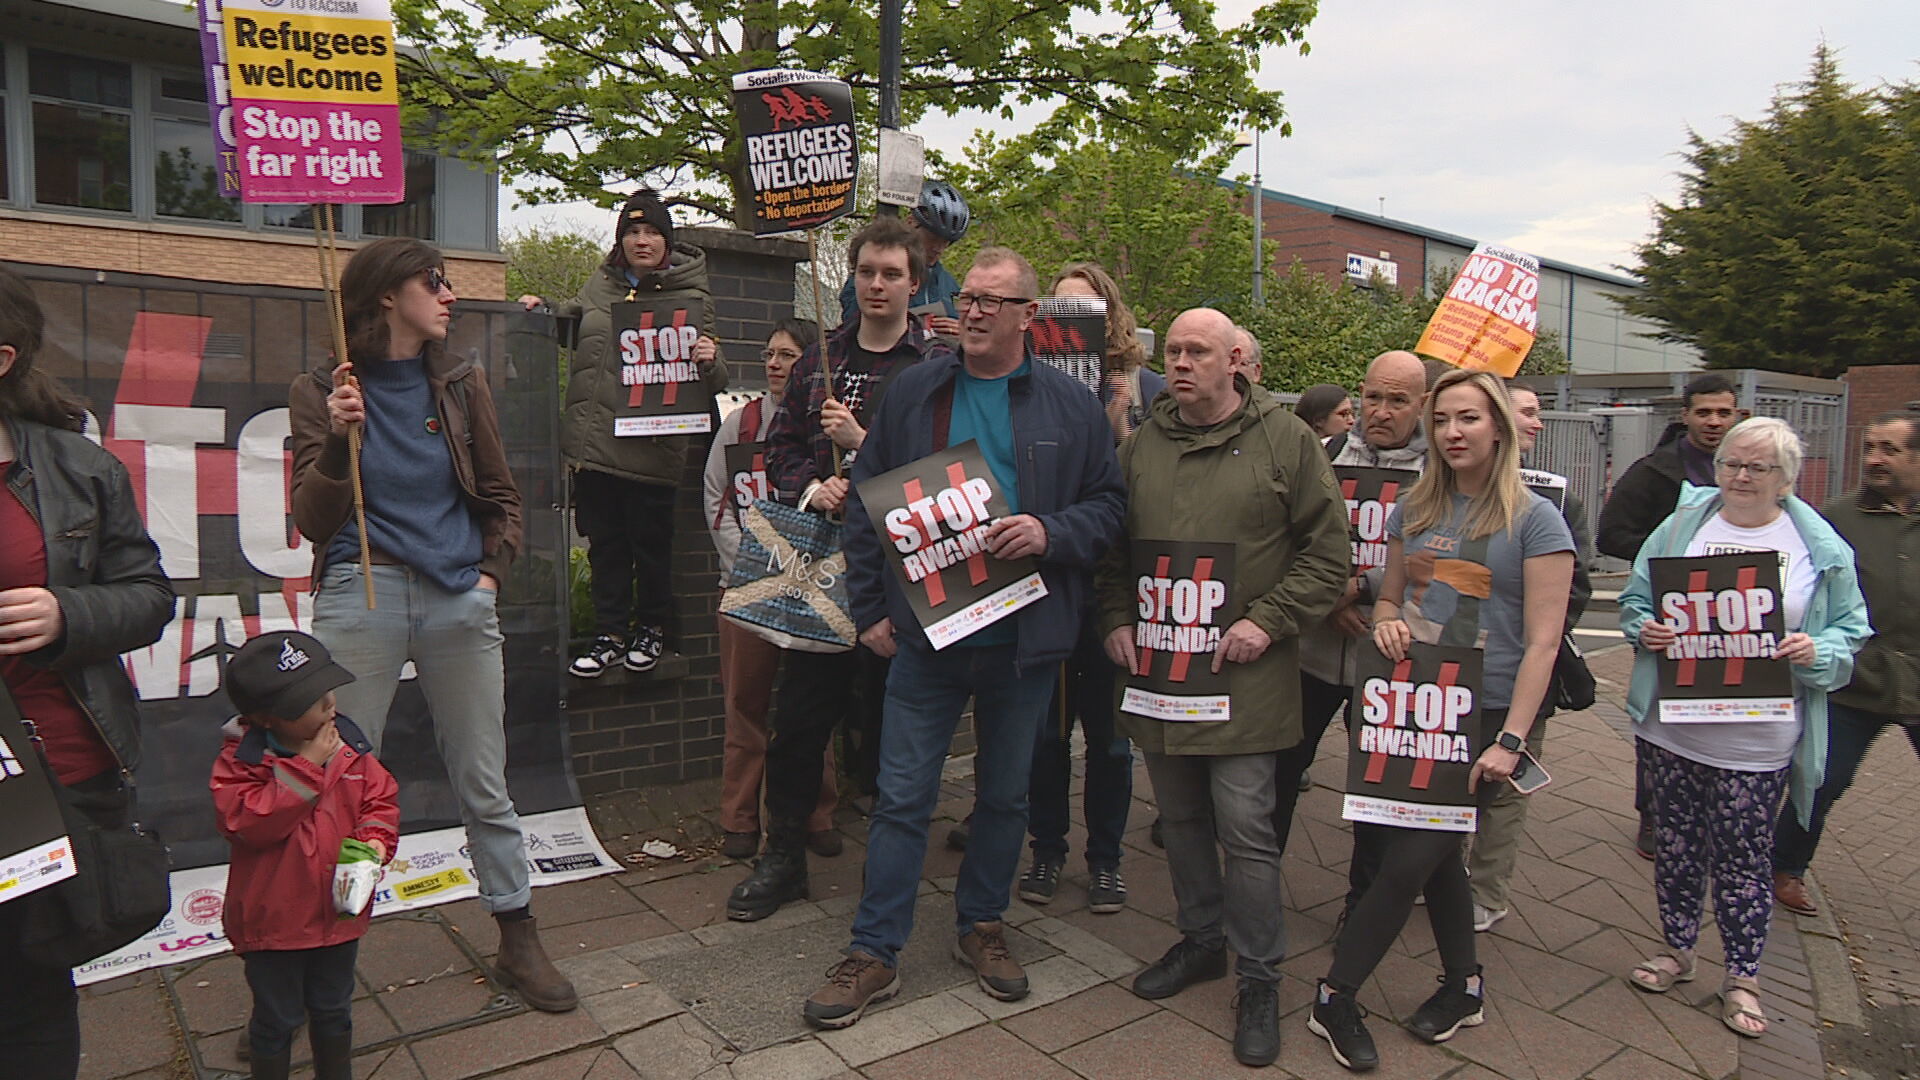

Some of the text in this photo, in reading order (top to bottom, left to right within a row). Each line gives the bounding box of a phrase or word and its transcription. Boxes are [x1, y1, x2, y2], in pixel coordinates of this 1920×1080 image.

[309, 0, 358, 14] RACISM
[234, 17, 388, 60] Refugees
[239, 58, 383, 92] welcome
[747, 72, 839, 87] SocialistWor
[243, 107, 382, 147] Stop the
[747, 123, 852, 164] REFUGEES
[247, 145, 296, 177] far
[305, 147, 383, 185] right
[750, 151, 855, 191] WELCOME
[764, 181, 851, 205] Open the borders
[766, 196, 845, 220] No deportations
[882, 191, 891, 199] NO
[1462, 256, 1539, 300] NO TO
[1484, 246, 1538, 274] SocialistWo
[1447, 304, 1510, 335] Refugees and
[1449, 276, 1537, 333] RACISM
[620, 325, 698, 365] STOP
[1434, 323, 1464, 339] Stamp
[1440, 313, 1522, 355] migrants welcome
[622, 361, 700, 387] RWANDA
[885, 477, 993, 555] STOP
[766, 544, 836, 590] M&S
[777, 582, 813, 602] FOOD
[1137, 575, 1226, 625] STOP
[1661, 588, 1774, 634] STOP
[1136, 620, 1221, 654] RWANDA
[1666, 632, 1778, 660] RWANDA
[1362, 677, 1473, 731] STOP
[1360, 725, 1471, 763] RWANDA
[402, 877, 440, 893] AMNESTY
[79, 952, 152, 974] UNISON
